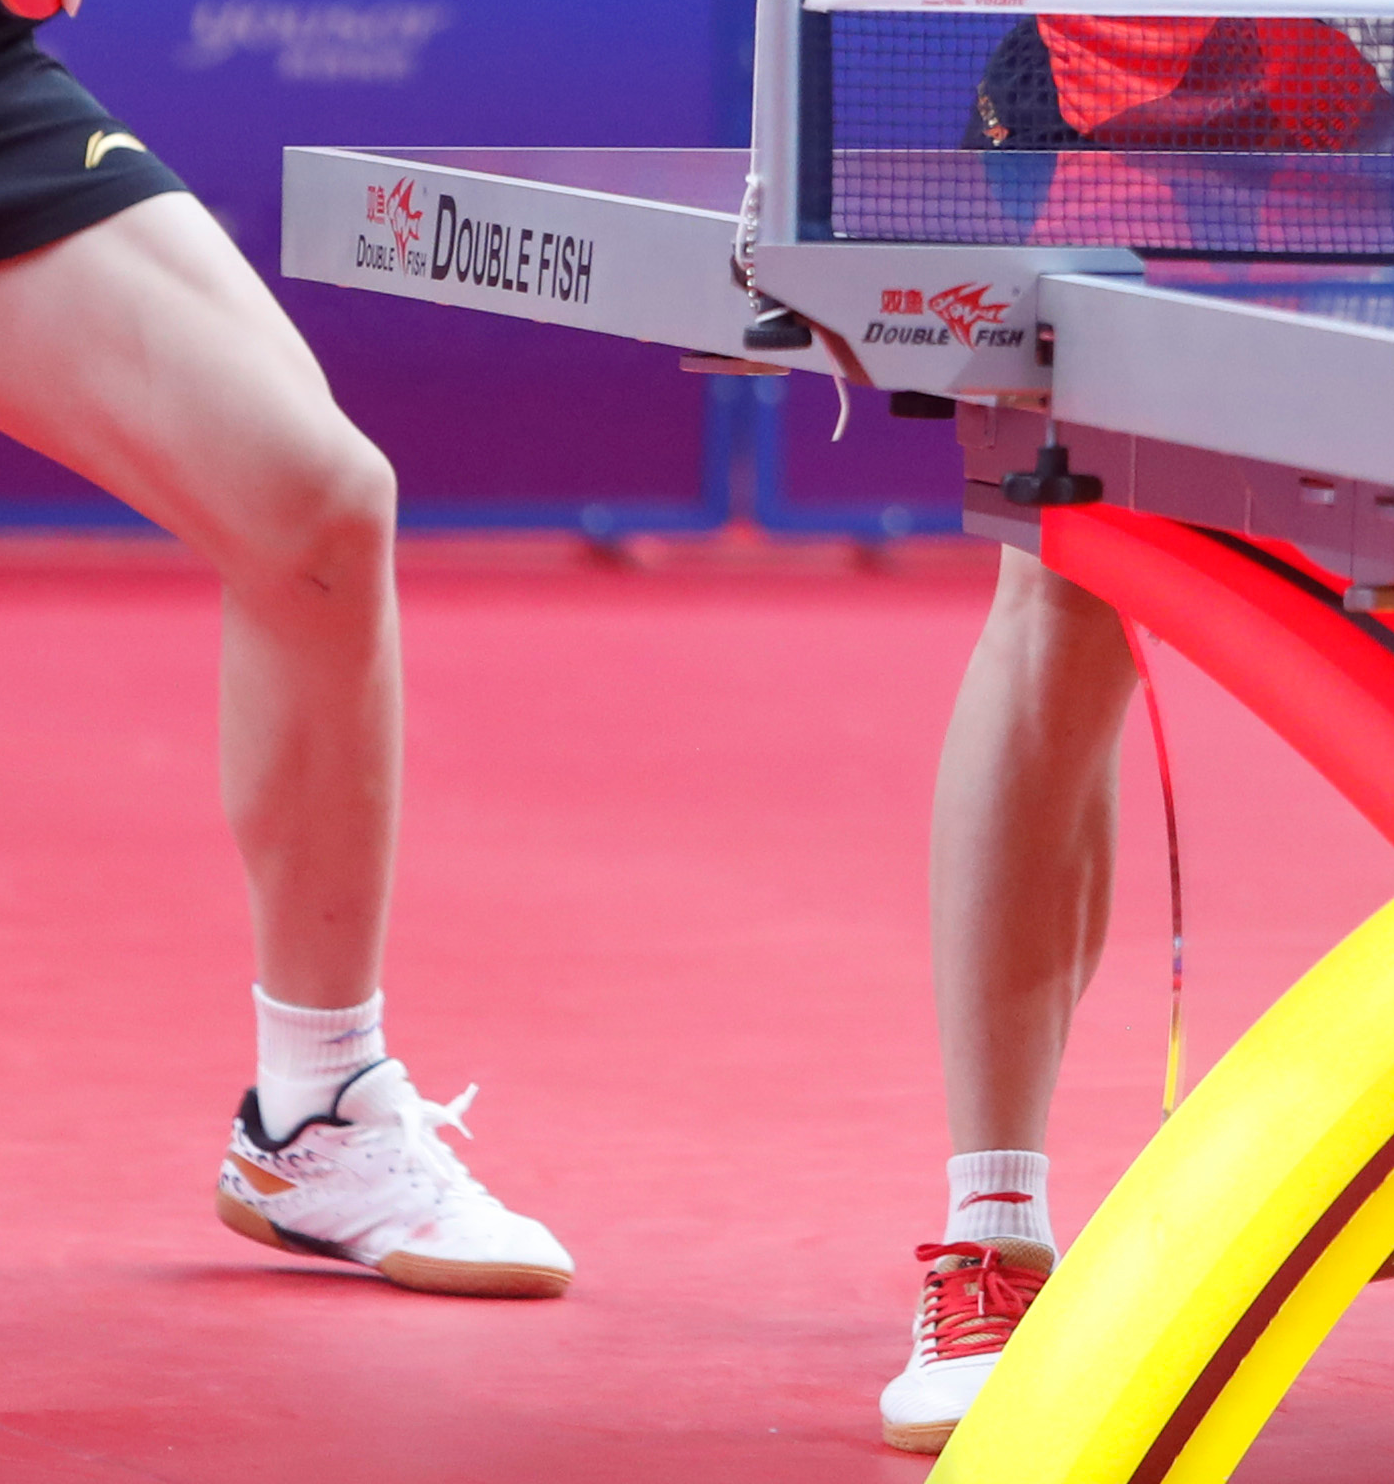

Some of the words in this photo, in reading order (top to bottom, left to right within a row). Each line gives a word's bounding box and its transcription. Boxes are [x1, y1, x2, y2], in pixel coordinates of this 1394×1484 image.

[356, 234, 395, 272] DOUBLE
[406, 250, 427, 277] FISH
[431, 194, 534, 294] DOUBLE
[537, 233, 594, 304] FISH
[863, 322, 951, 346] DOUBLE
[975, 329, 1025, 347] FISH
